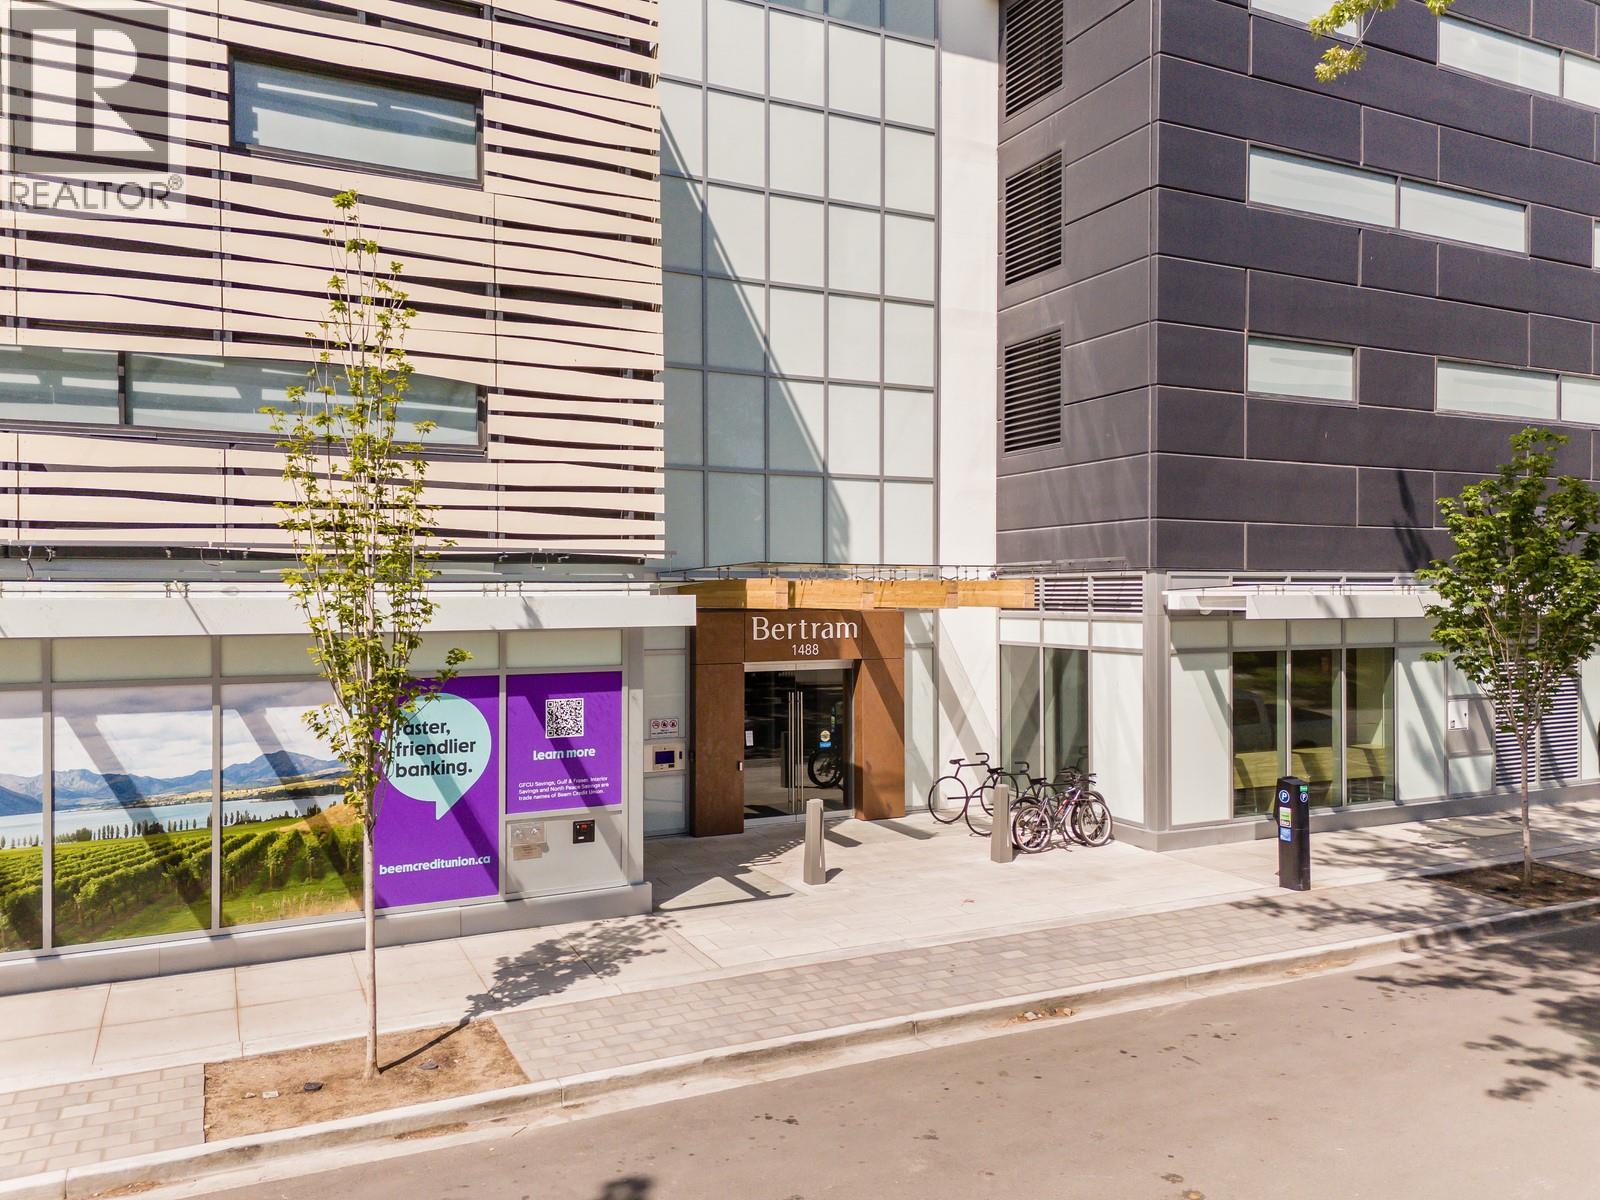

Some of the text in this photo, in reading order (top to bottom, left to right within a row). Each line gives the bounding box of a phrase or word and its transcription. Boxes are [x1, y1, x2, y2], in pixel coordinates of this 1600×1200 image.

[751, 616, 858, 641] Bertram
[791, 643, 819, 656] 1488
[395, 738, 476, 757] friendlier
[533, 748, 596, 760] Learn more
[395, 760, 473, 778] banking.
[379, 855, 491, 875] beemcreditunion.ca
